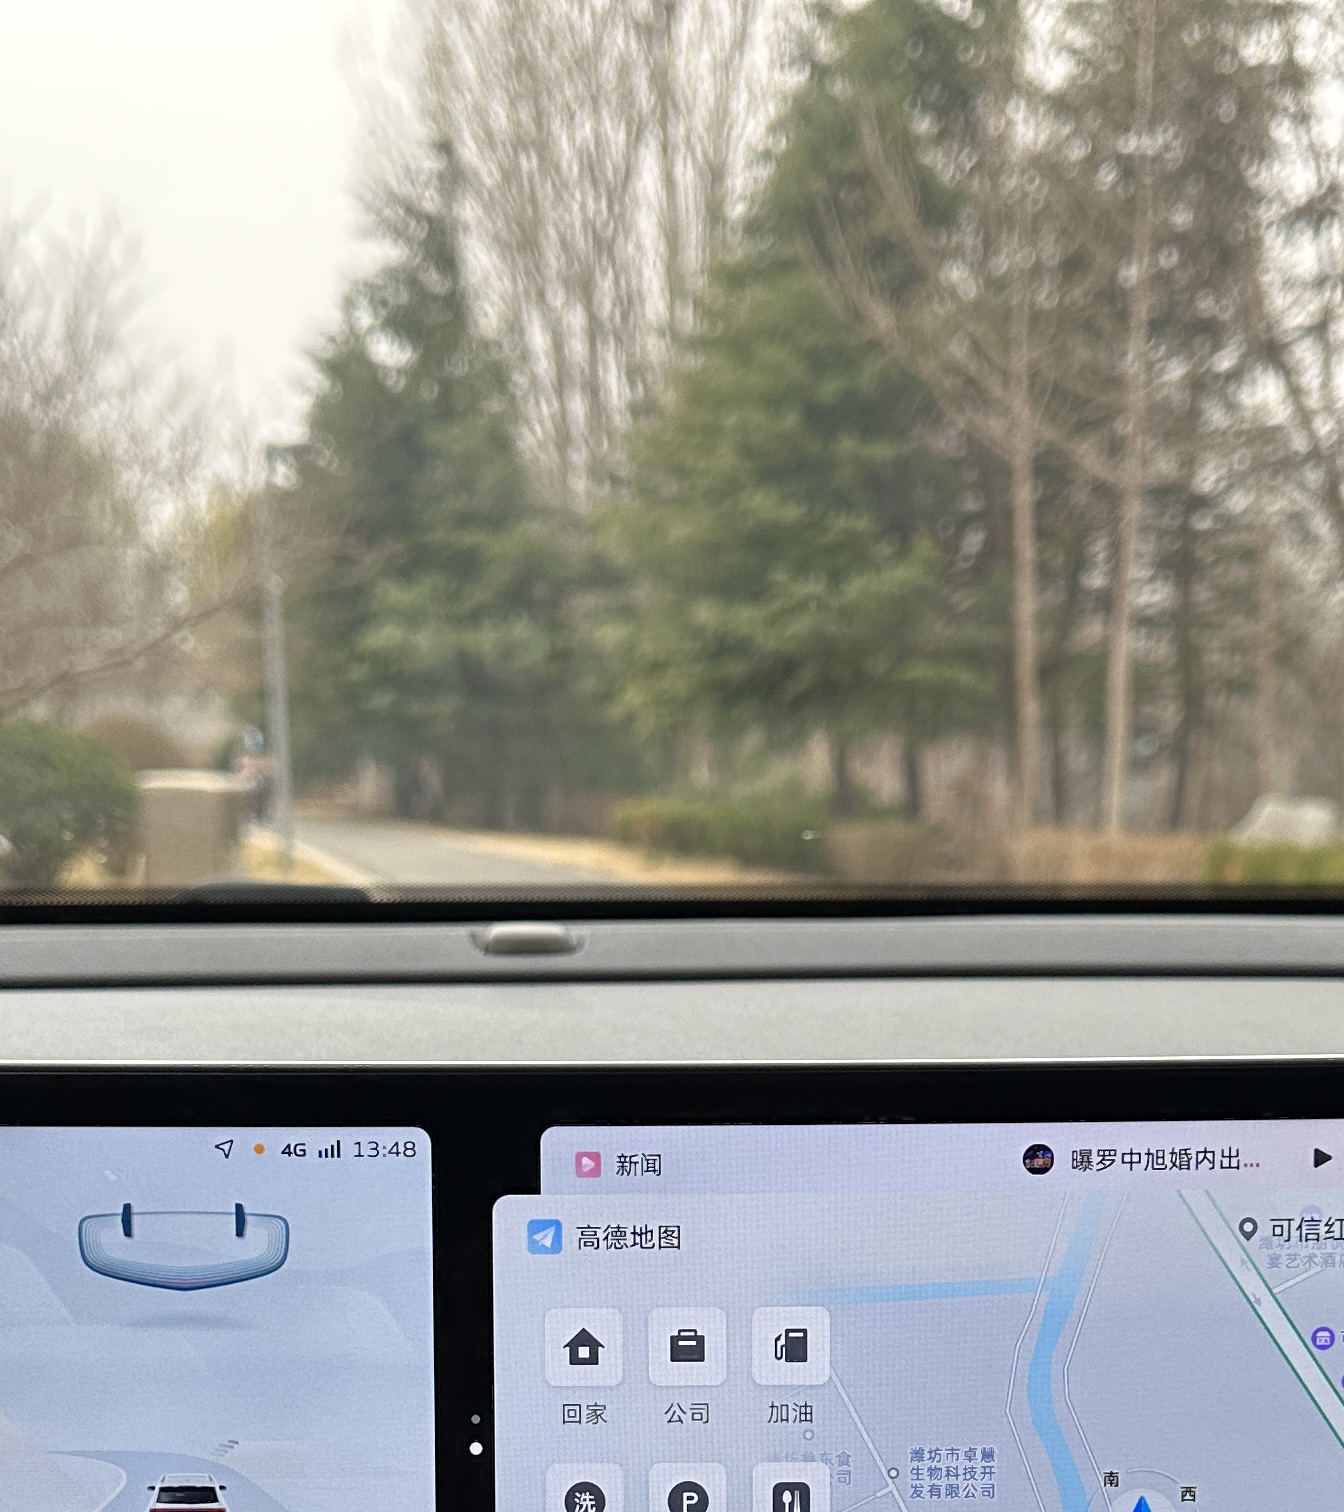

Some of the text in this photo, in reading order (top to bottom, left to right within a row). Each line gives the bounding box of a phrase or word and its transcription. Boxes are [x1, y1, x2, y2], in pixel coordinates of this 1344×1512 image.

[280, 1142, 308, 1158] 4G
[352, 1139, 417, 1159] 13:48
[615, 1152, 662, 1177] 新闻
[575, 1223, 682, 1251] 高德地图
[561, 1402, 608, 1426] 回家
[664, 1401, 711, 1425] 公司
[767, 1401, 814, 1425] 加油
[909, 1464, 997, 1482] 生物科技开
[1102, 1470, 1120, 1488] 南
[908, 1482, 996, 1500] 发有限公司
[1180, 1485, 1197, 1503] 西
